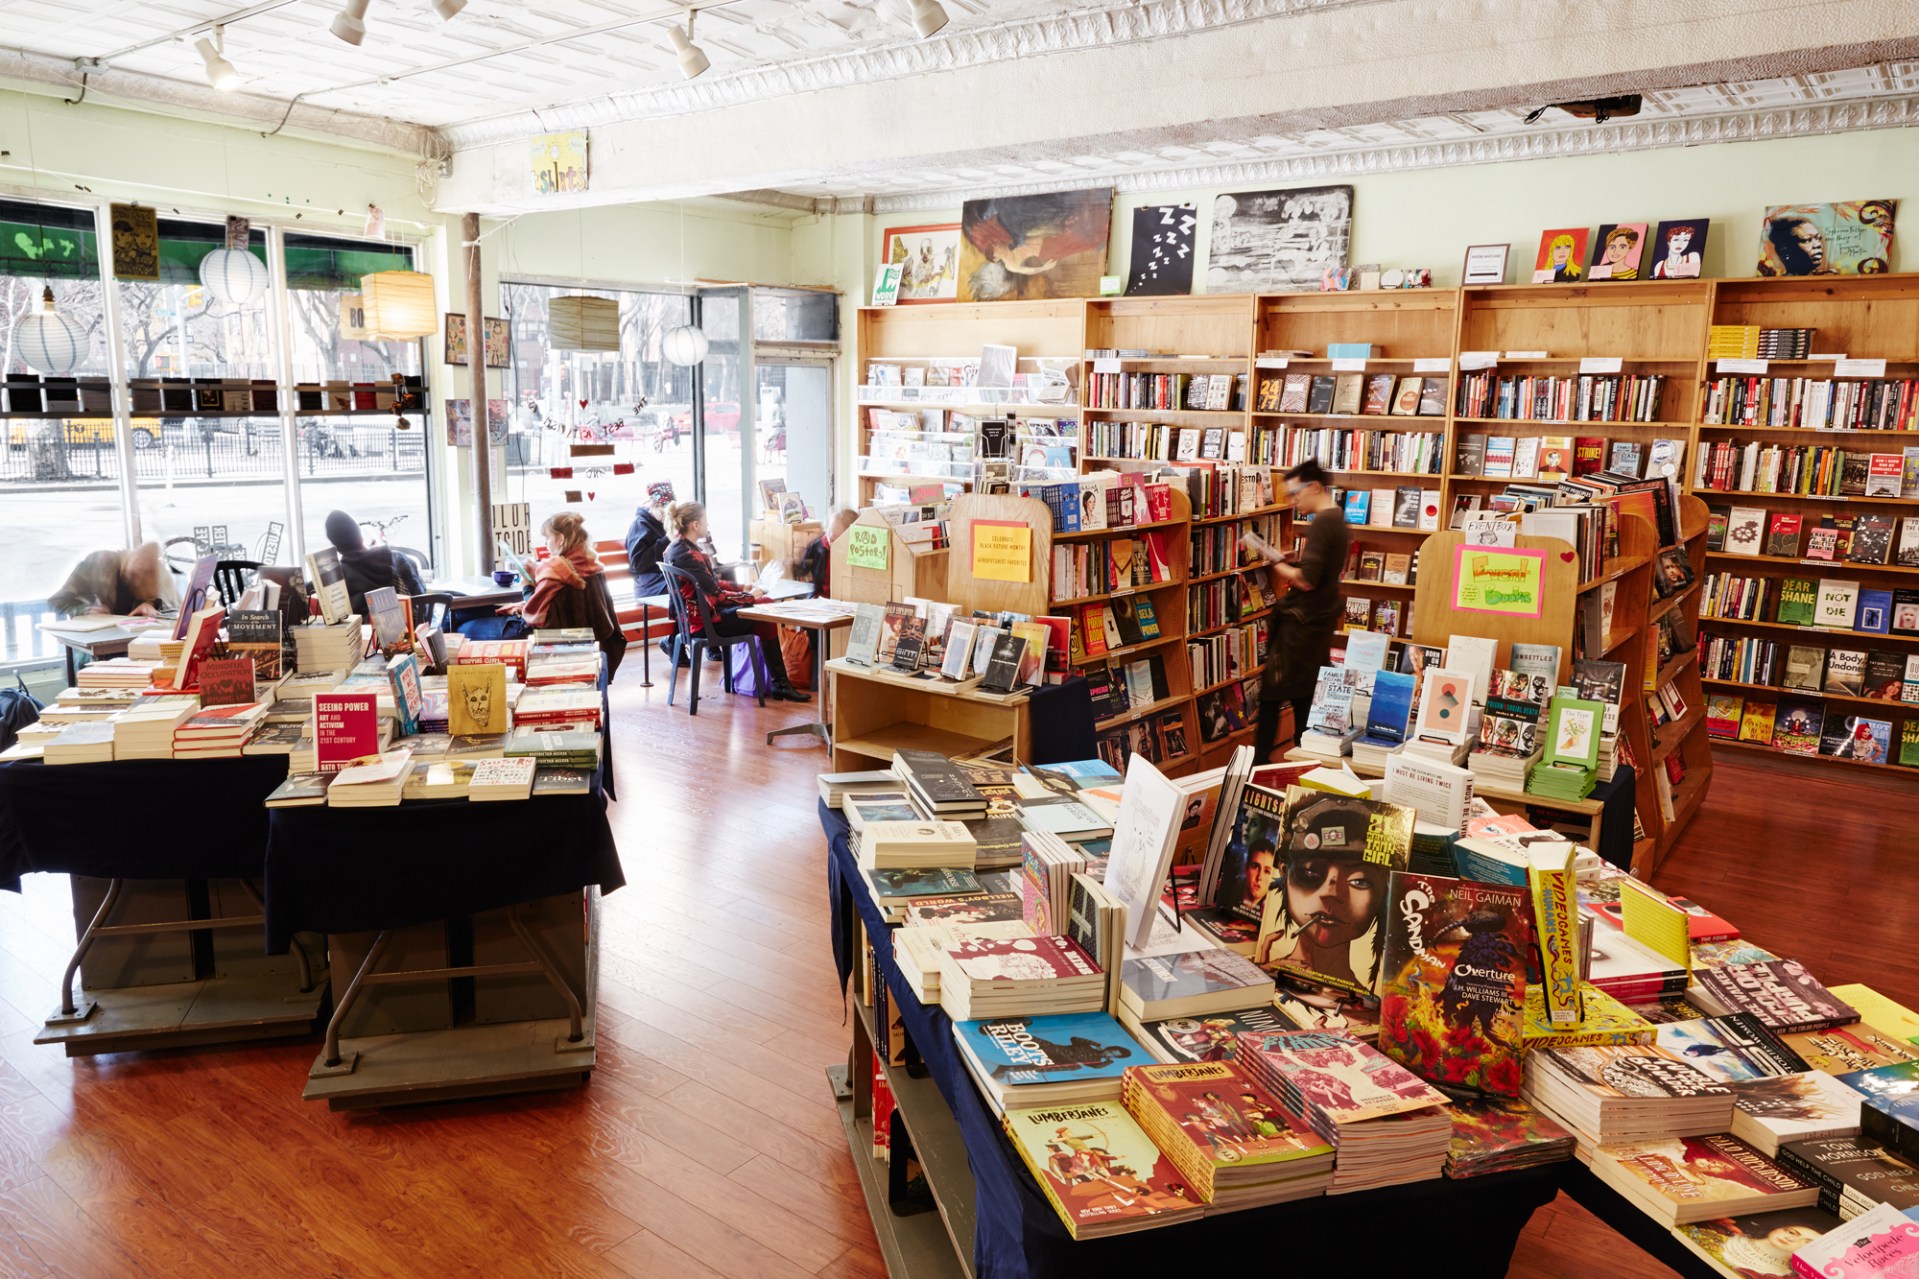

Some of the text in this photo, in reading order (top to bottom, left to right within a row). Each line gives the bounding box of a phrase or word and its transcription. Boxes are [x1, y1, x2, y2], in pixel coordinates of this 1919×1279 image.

[1577, 447, 1601, 459] STRIKE!
[1468, 522, 1497, 531] EVENT
[1471, 555, 1530, 583] Event
[1783, 579, 1810, 591] DEAR
[1825, 593, 1852, 602] NOT
[1826, 607, 1846, 616] DIE
[484, 657, 502, 665] GIRL
[1515, 654, 1553, 662] UNSETTLED
[1840, 652, 1864, 665] Body
[206, 662, 245, 671] MINDFUL
[1828, 661, 1864, 672] Undone
[201, 669, 250, 679] OCCUPATION
[1328, 685, 1352, 694] STATE
[318, 702, 369, 712] SEEING POWER
[1488, 701, 1503, 709] PRISON
[1507, 704, 1522, 713] SOCIAL
[1523, 706, 1539, 715] DEATH
[1417, 774, 1434, 784] LIVING
[1435, 779, 1452, 789] TWICE
[1464, 783, 1473, 805] MUST
[1463, 807, 1470, 818] BE
[1366, 838, 1396, 855] TANK
[1363, 850, 1392, 867] GIRL
[1417, 881, 1435, 904] The
[1450, 888, 1522, 908] NEIL GAIMAN
[914, 898, 961, 907] WORLD
[1551, 872, 1573, 965] VIDEOGAMES
[1400, 889, 1446, 969] SANDMAN
[1454, 964, 1516, 982] Overture
[1461, 991, 1514, 1005] DAVE STEWART
[1466, 985, 1500, 997] WILLIAMS
[987, 1024, 1031, 1064] RILEY
[1006, 1022, 1055, 1067] BOOTS
[1522, 1033, 1603, 1048] VIDEOGAMES
[1150, 1065, 1224, 1080] LUMBERJANES
[1028, 1107, 1109, 1126] LUMBERJANES
[1819, 1142, 1857, 1151] TONI
[1737, 1152, 1803, 1191] HOPKINSON
[1781, 1149, 1799, 1160] GOD
[1822, 1174, 1841, 1189] CHILD
[1856, 1167, 1915, 1181] GOD HELP
[1079, 1209, 1108, 1218] BESTSELLING
[1844, 1232, 1903, 1268] Velocipede
[1867, 1248, 1903, 1269] Races
